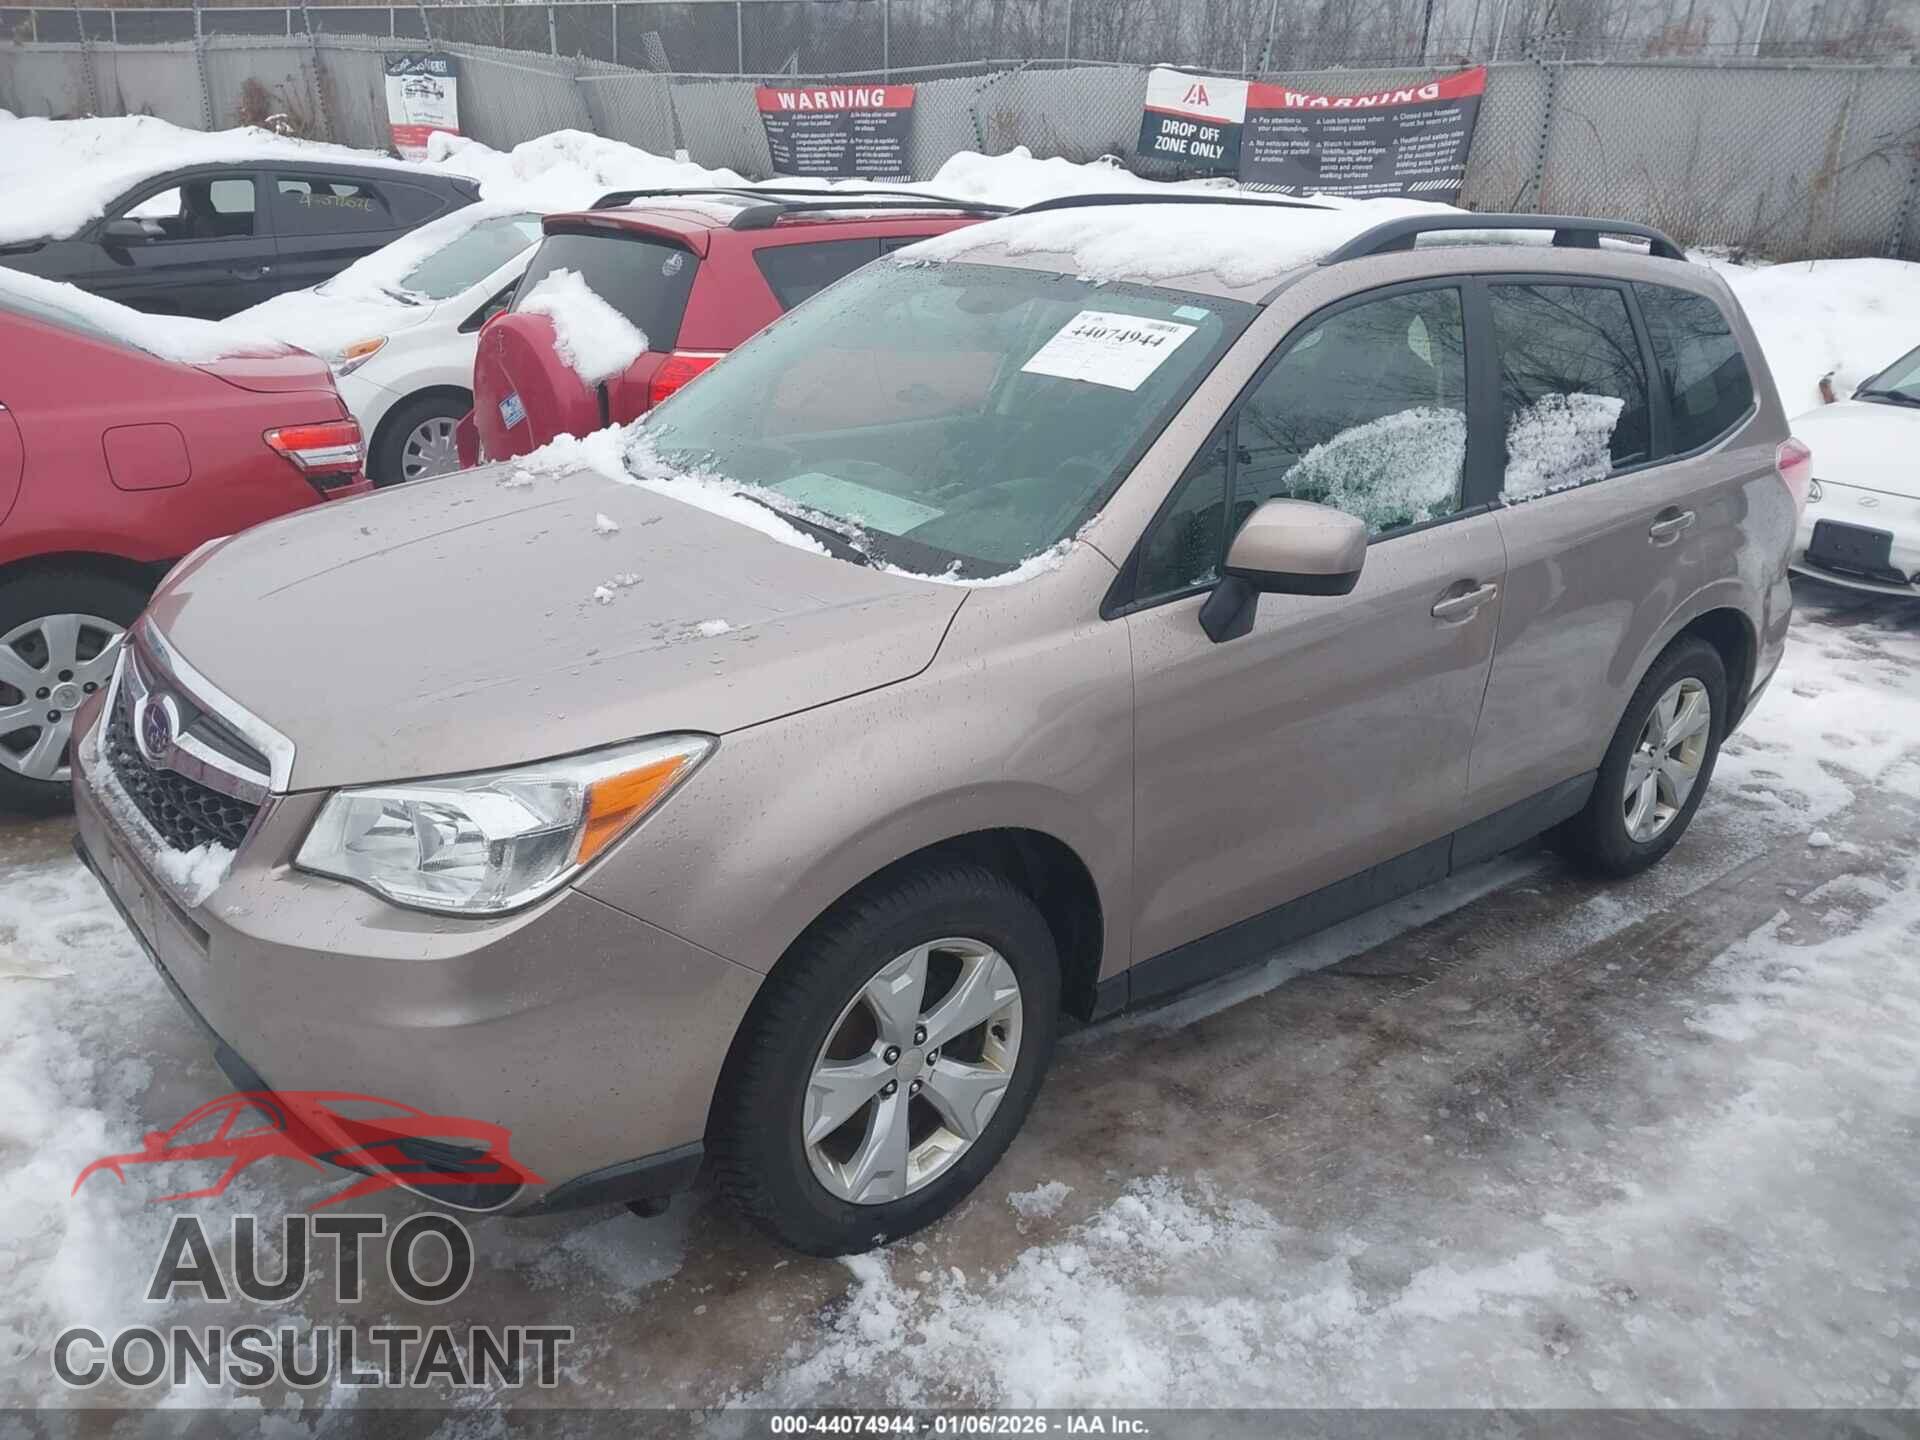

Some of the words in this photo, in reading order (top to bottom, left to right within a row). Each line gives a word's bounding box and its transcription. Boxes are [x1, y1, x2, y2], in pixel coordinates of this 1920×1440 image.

[777, 89, 885, 109] WARNING
[1284, 83, 1439, 107] WARNING
[1162, 120, 1197, 137] DROP
[1199, 127, 1220, 142] OFF
[1154, 136, 1188, 153] ZONE
[1190, 141, 1224, 159] ONLY
[1071, 324, 1167, 348] 44074944
